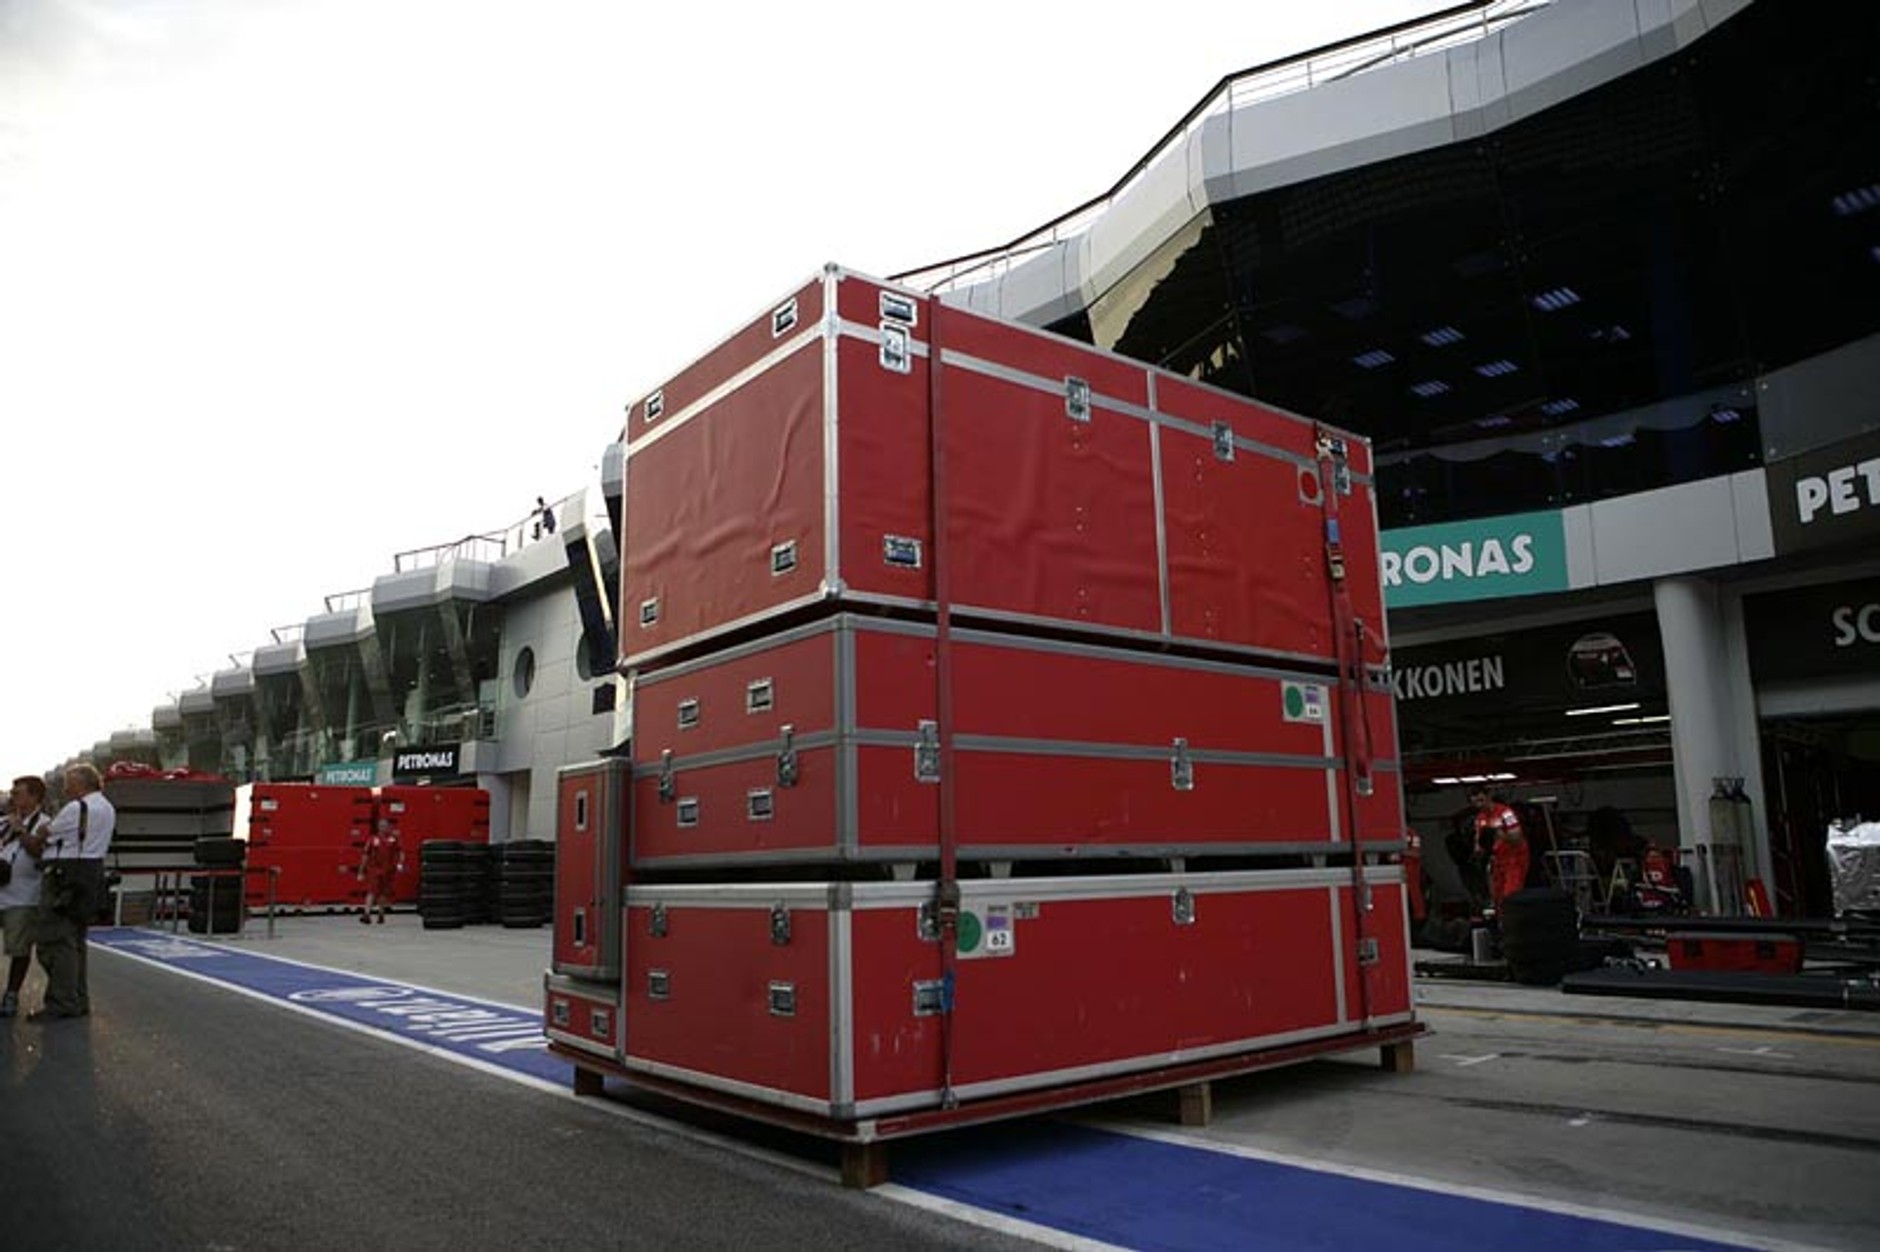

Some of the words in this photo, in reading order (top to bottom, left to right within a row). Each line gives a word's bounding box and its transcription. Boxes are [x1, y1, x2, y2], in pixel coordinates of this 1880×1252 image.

[1796, 457, 1880, 523] PET
[1381, 534, 1534, 587] RONAS
[327, 768, 371, 782] PETRONAS
[398, 752, 453, 770] PETRONAS
